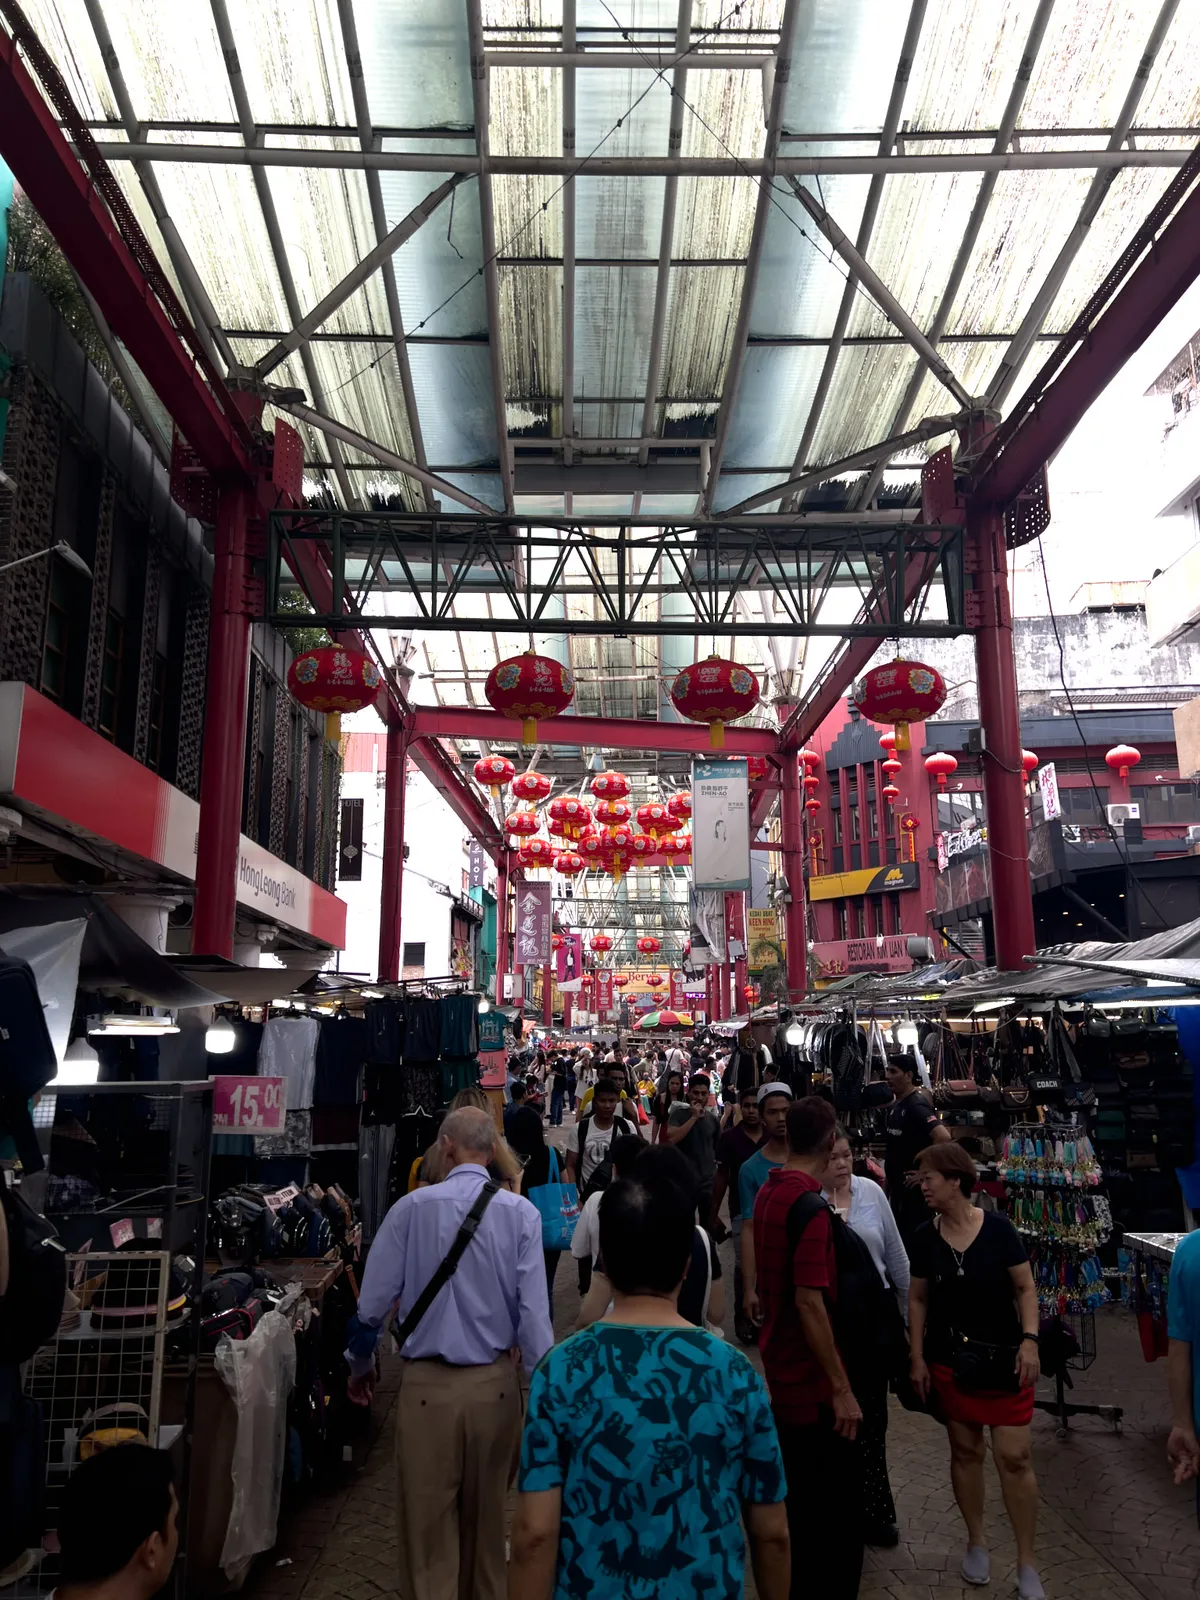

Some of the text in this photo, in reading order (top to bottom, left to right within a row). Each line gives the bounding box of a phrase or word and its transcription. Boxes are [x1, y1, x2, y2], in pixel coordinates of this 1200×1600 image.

[281, 882, 296, 909] Bank
[749, 918, 761, 926] KEEN
[847, 944, 875, 961] RESTORAN
[1036, 1080, 1058, 1088] COACH
